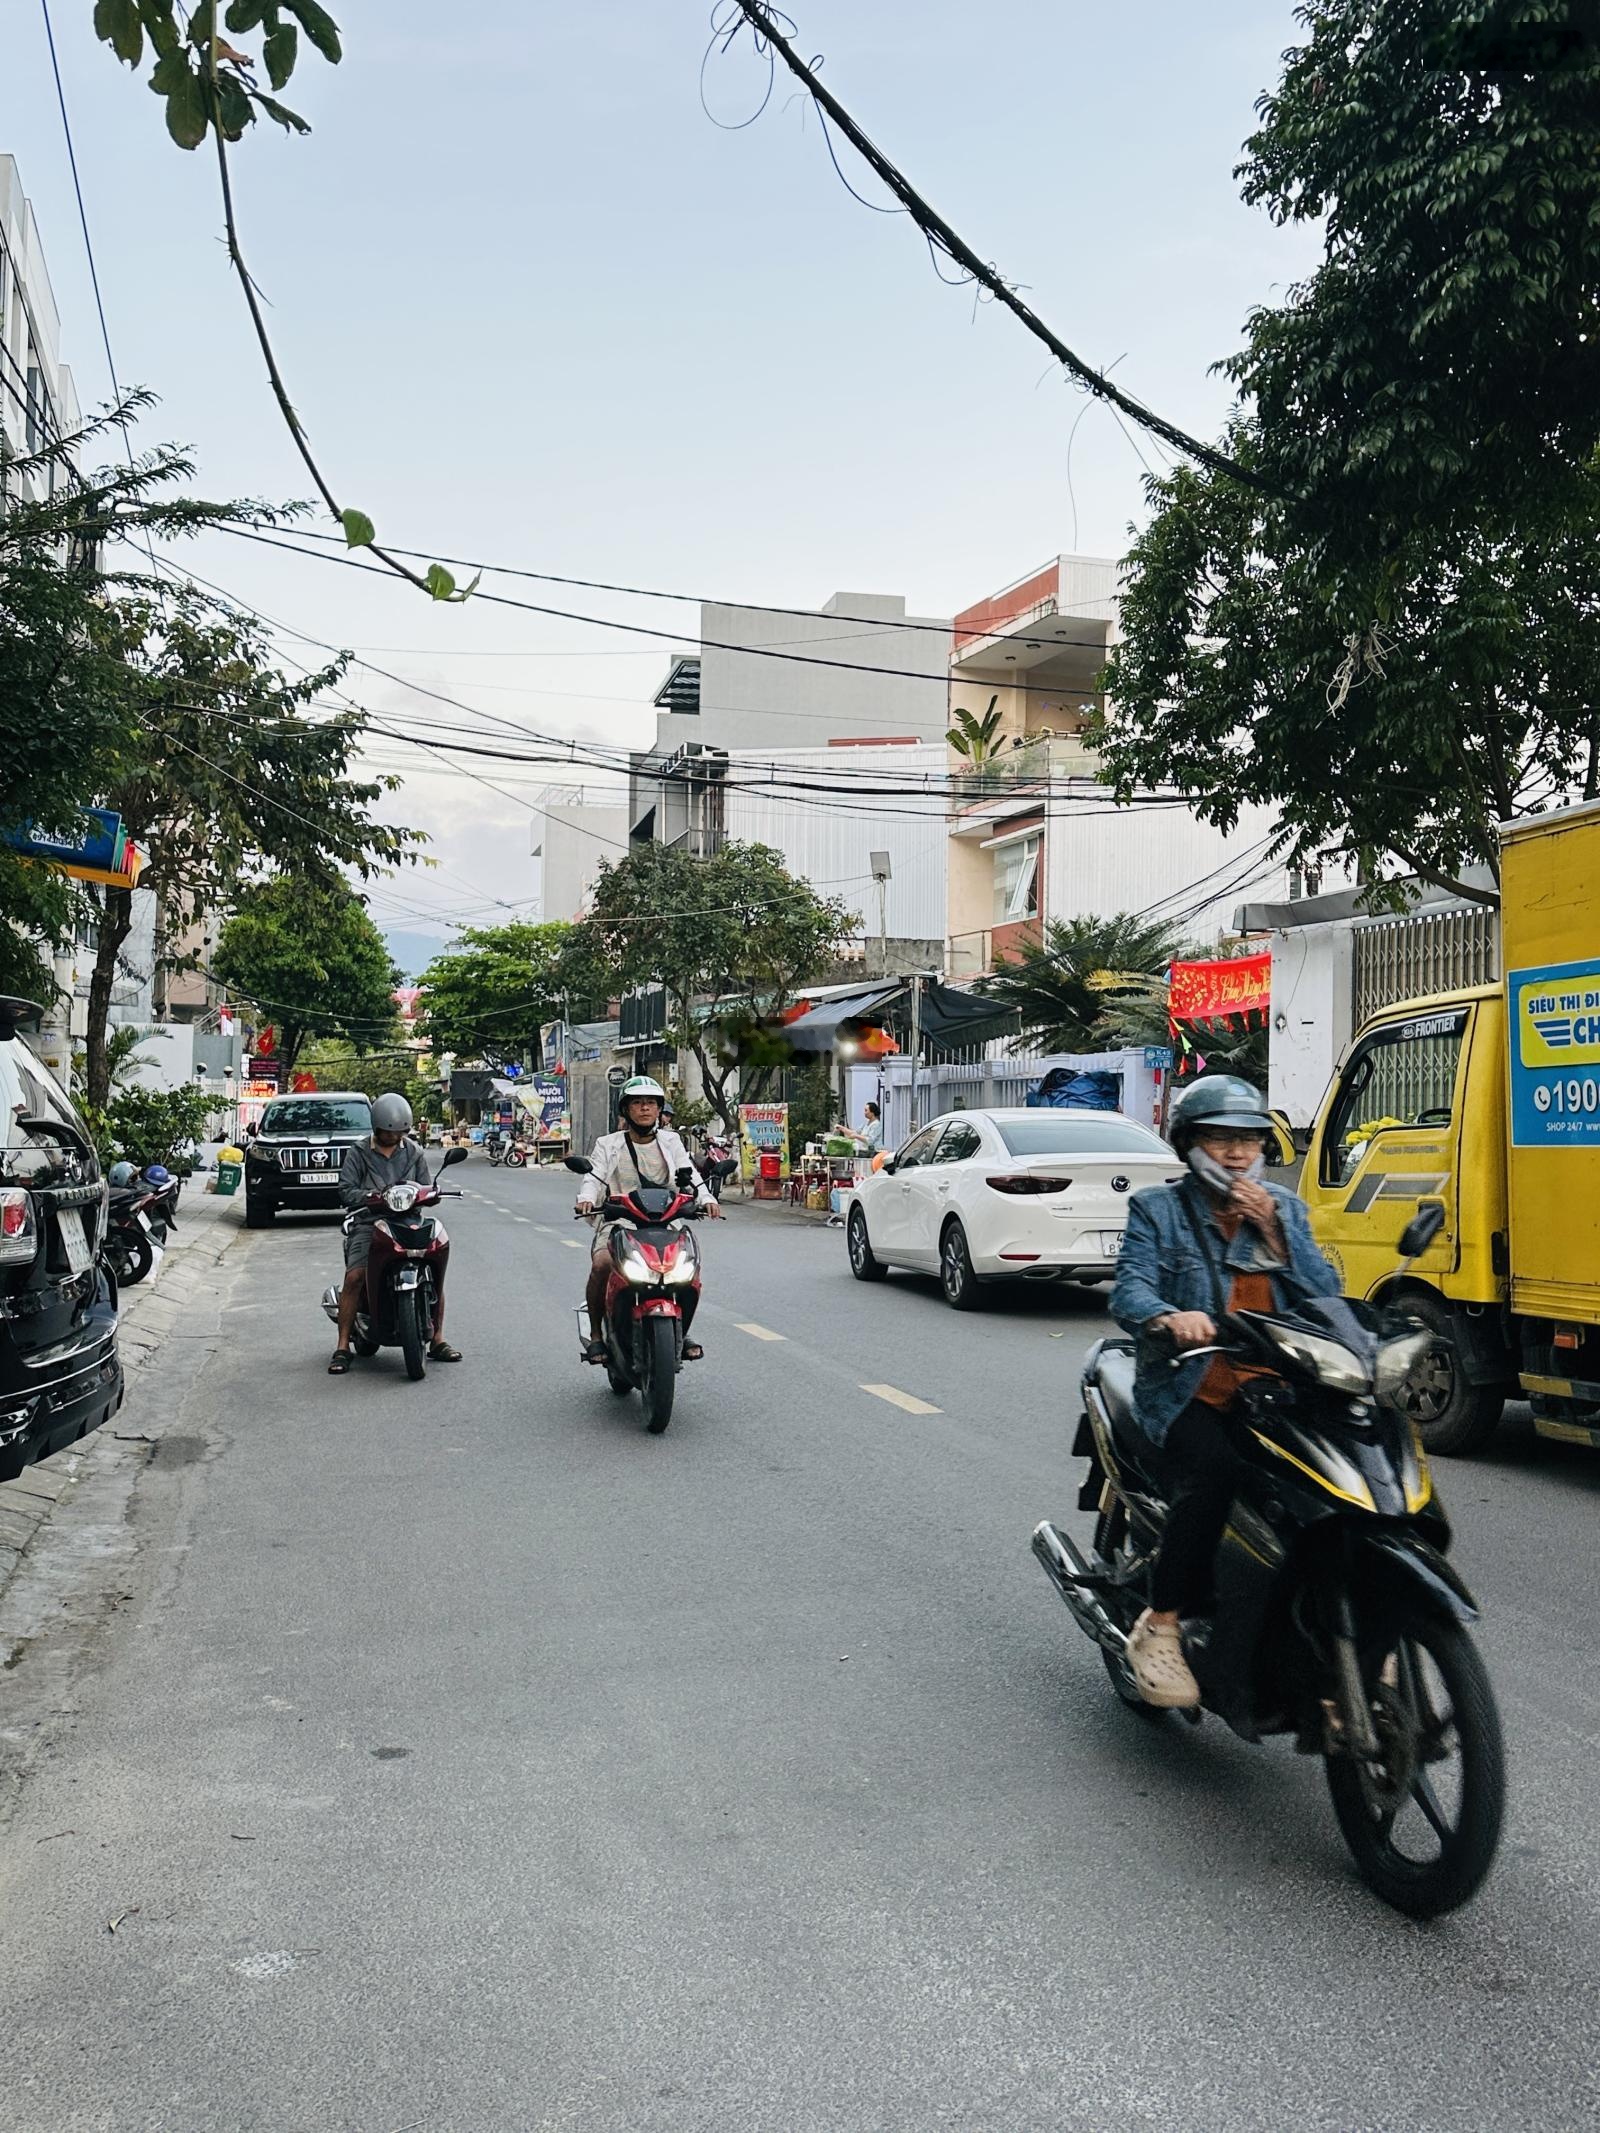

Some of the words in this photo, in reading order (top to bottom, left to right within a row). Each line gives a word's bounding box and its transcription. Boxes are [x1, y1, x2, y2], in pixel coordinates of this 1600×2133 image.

[1559, 994, 1580, 1013] THỊ
[1415, 1016, 1456, 1037] FRONTIER
[1553, 1078, 1600, 1112] 190
[1546, 1121, 1566, 1132] SHOP
[1567, 1121, 1583, 1132] 24/7
